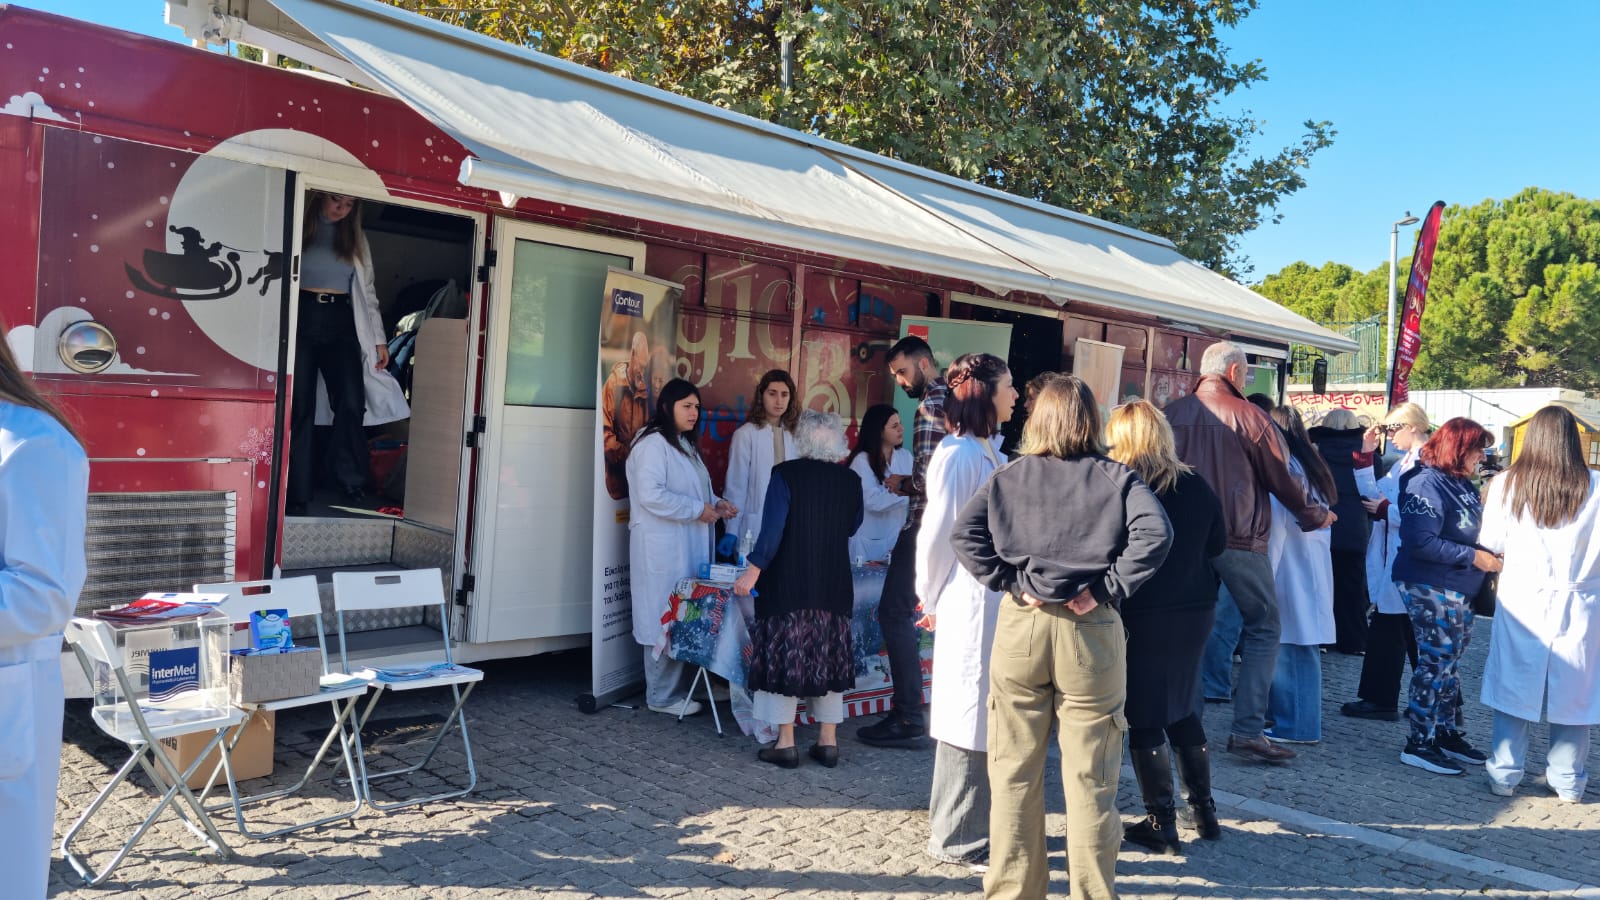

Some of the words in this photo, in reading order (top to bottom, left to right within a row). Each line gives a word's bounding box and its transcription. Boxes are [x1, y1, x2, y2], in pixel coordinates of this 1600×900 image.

[614, 293, 641, 309] Contour
[603, 582, 613, 593] για
[151, 662, 197, 680] InterMed
